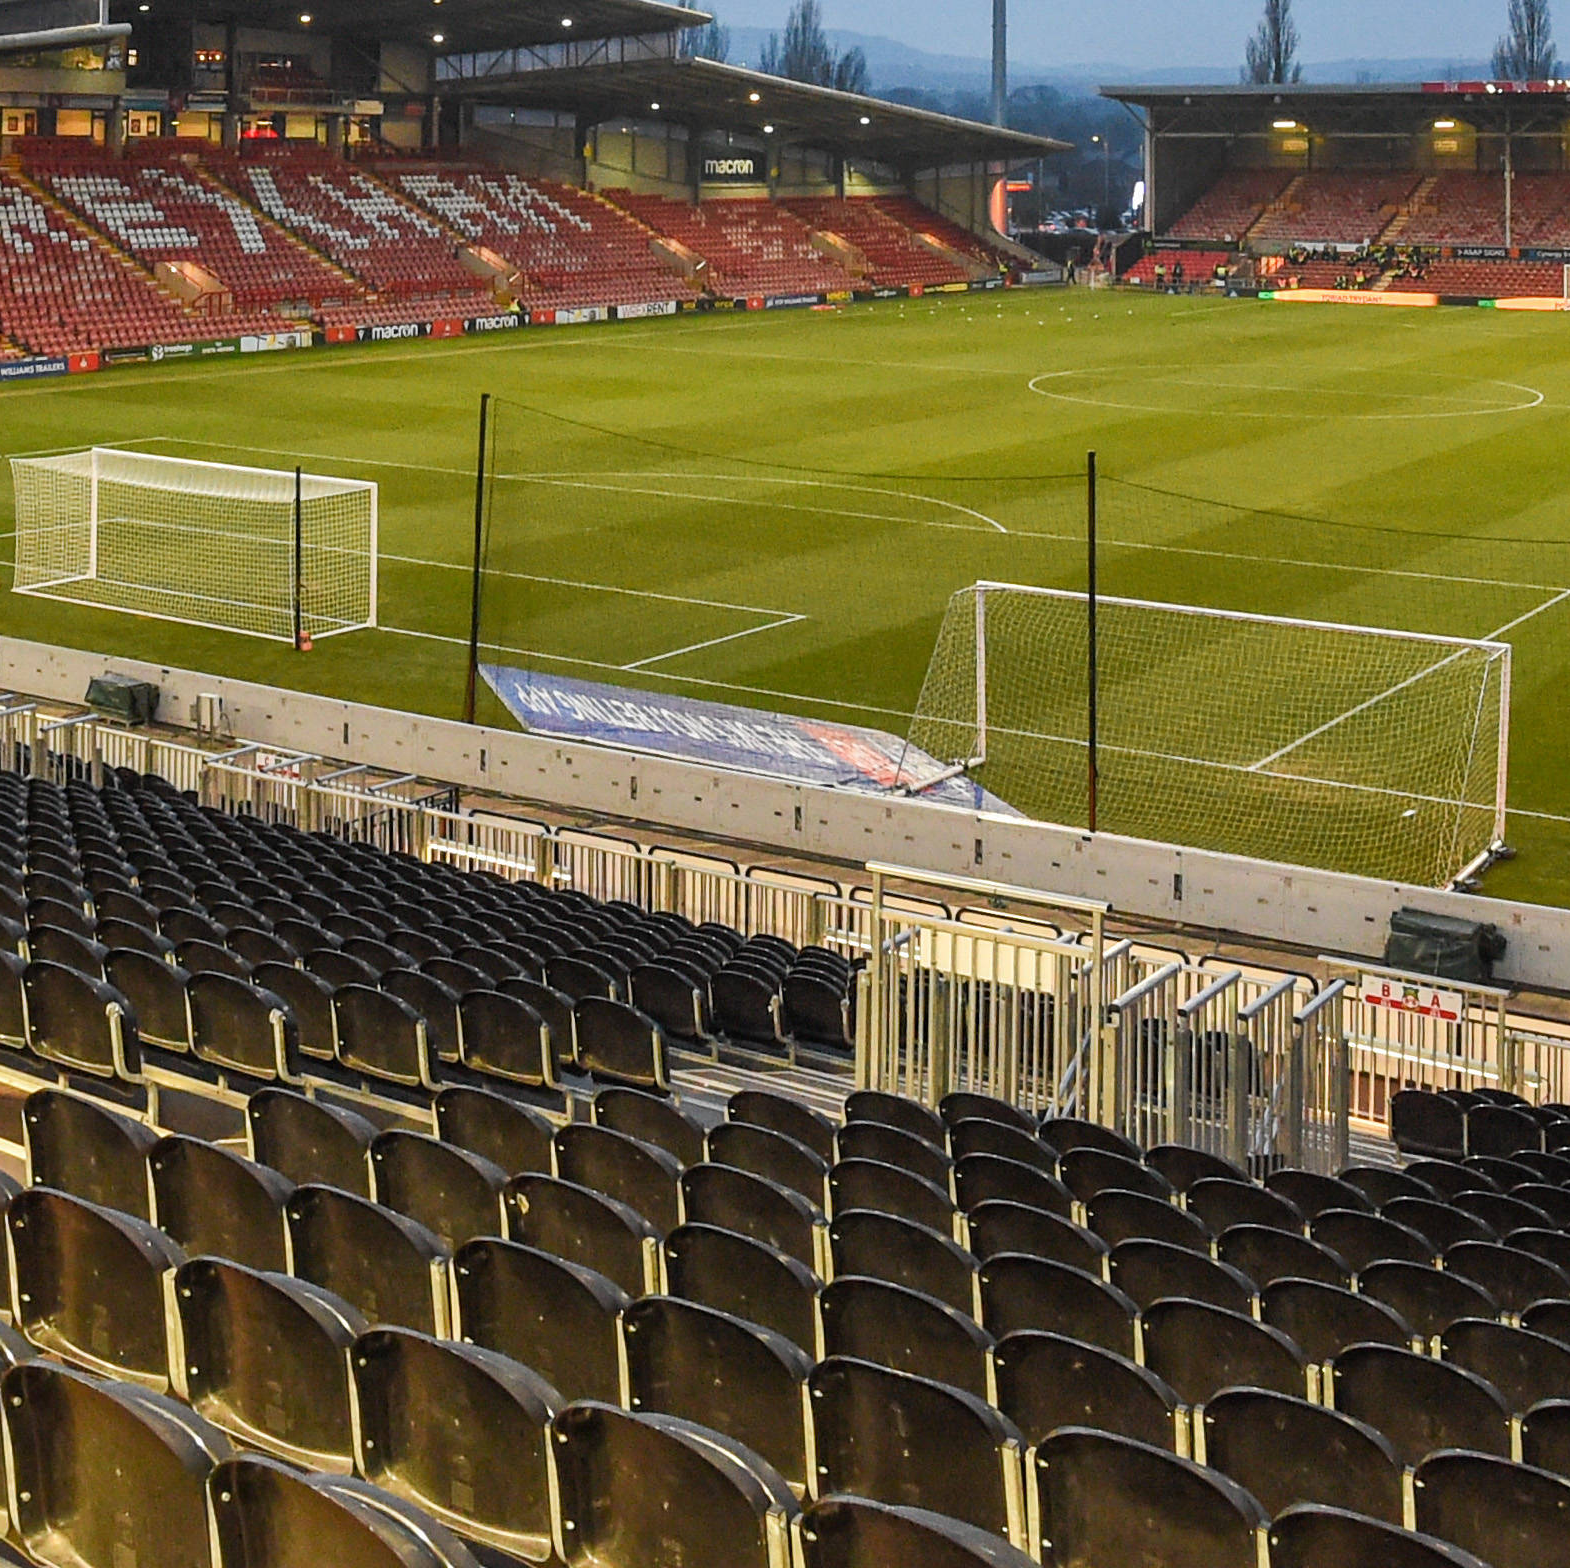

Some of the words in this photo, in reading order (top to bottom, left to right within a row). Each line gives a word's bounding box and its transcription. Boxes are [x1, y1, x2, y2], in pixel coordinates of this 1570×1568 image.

[705, 159, 754, 174] macron
[372, 323, 418, 340] macron
[476, 314, 518, 330] macron
[513, 682, 562, 717] APP
[551, 689, 663, 730] BETTING
[639, 705, 721, 743] NO.1
